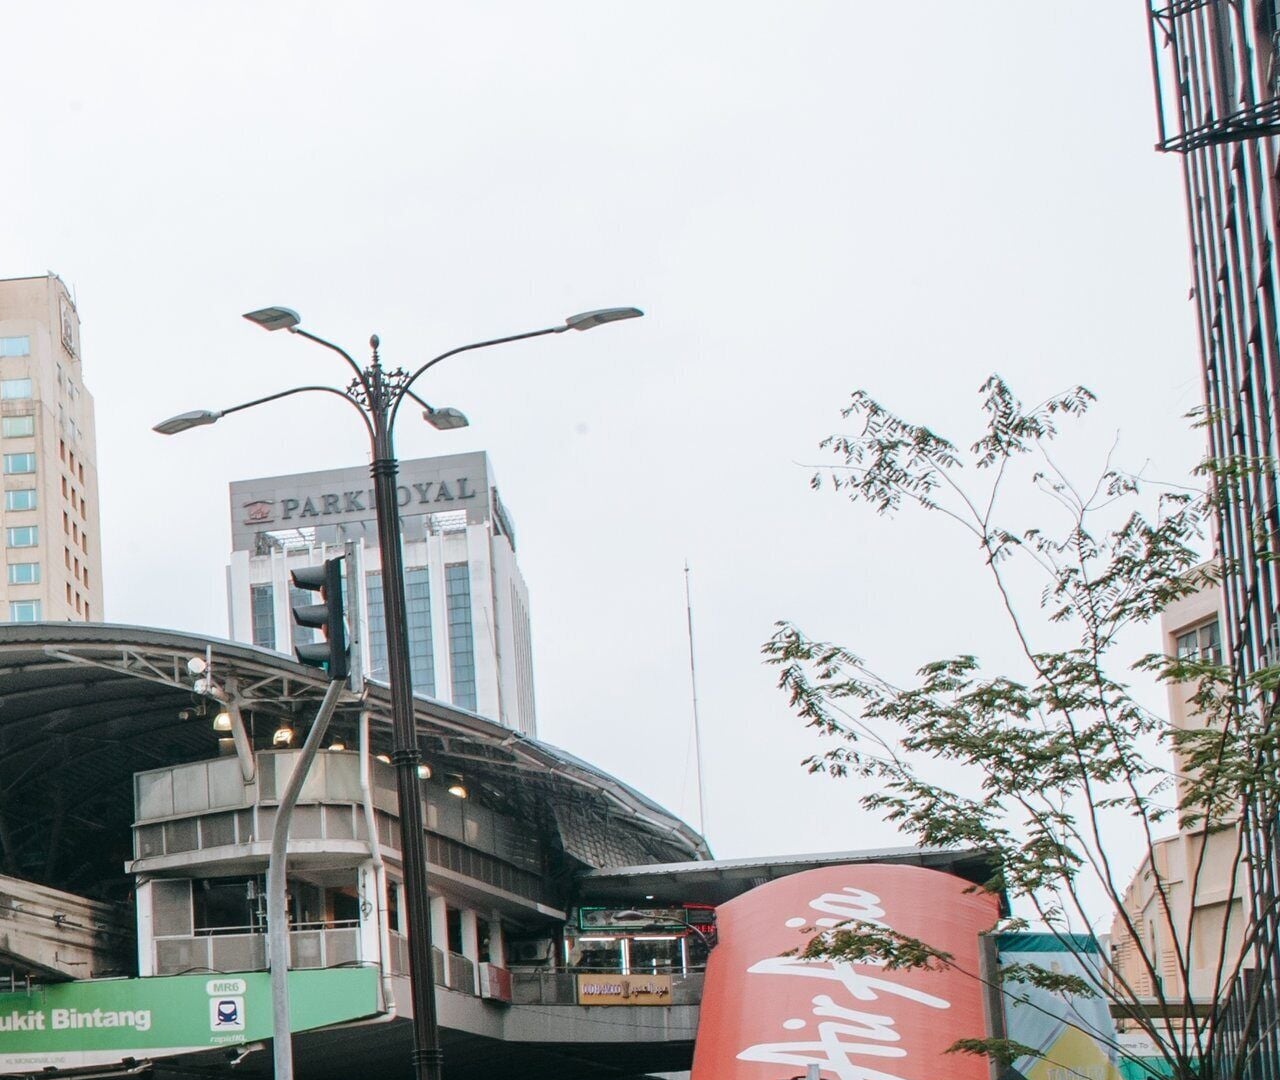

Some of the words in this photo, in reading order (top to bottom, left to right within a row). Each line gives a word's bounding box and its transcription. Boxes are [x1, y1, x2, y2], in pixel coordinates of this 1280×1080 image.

[281, 477, 476, 520] PARKOYAL
[213, 982, 240, 993] MR6
[51, 1008, 151, 1032] Bintang
